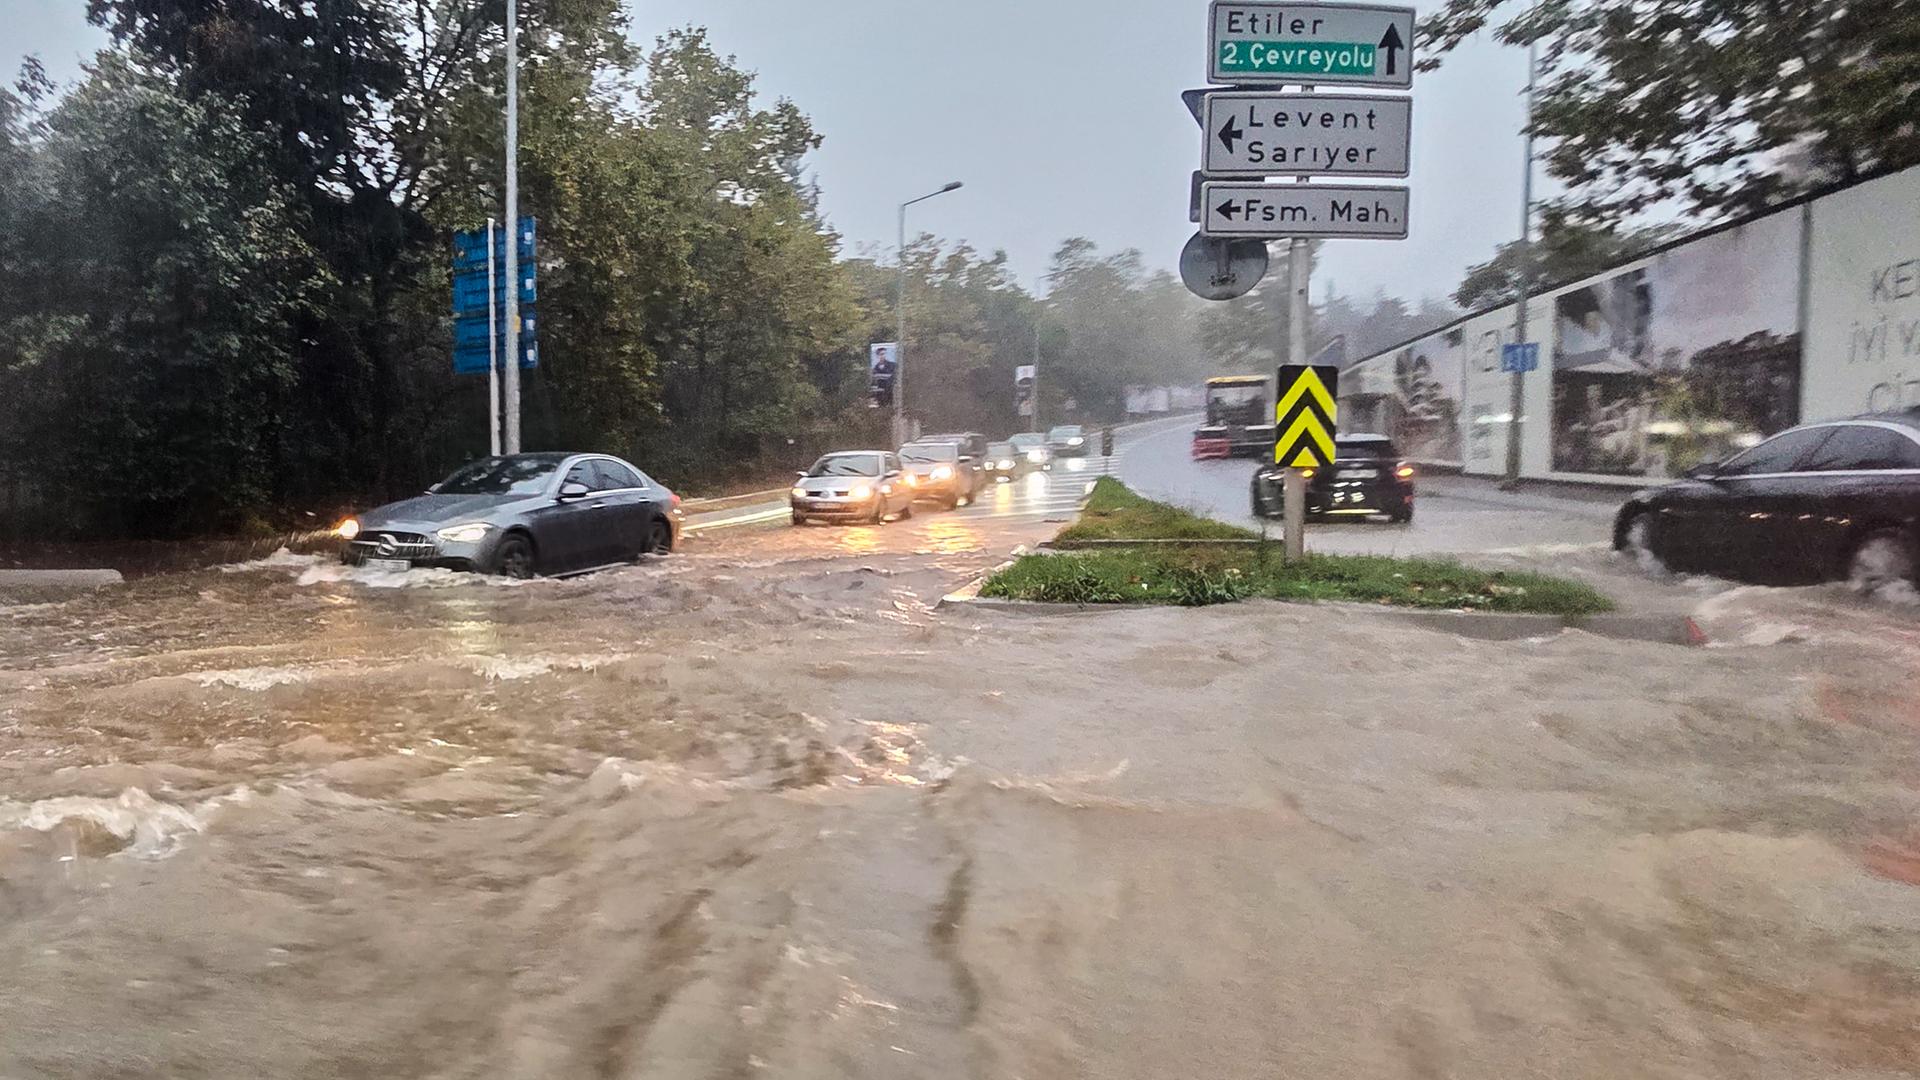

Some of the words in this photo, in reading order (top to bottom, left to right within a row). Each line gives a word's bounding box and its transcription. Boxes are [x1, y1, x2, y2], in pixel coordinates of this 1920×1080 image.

[1227, 11, 1324, 35] Etiler
[1222, 43, 1244, 65] 2.
[1250, 43, 1373, 72] Çevreyolu
[1249, 105, 1376, 130] Levent
[1244, 199, 1318, 222] Fsm.
[1330, 200, 1398, 223] Mah.
